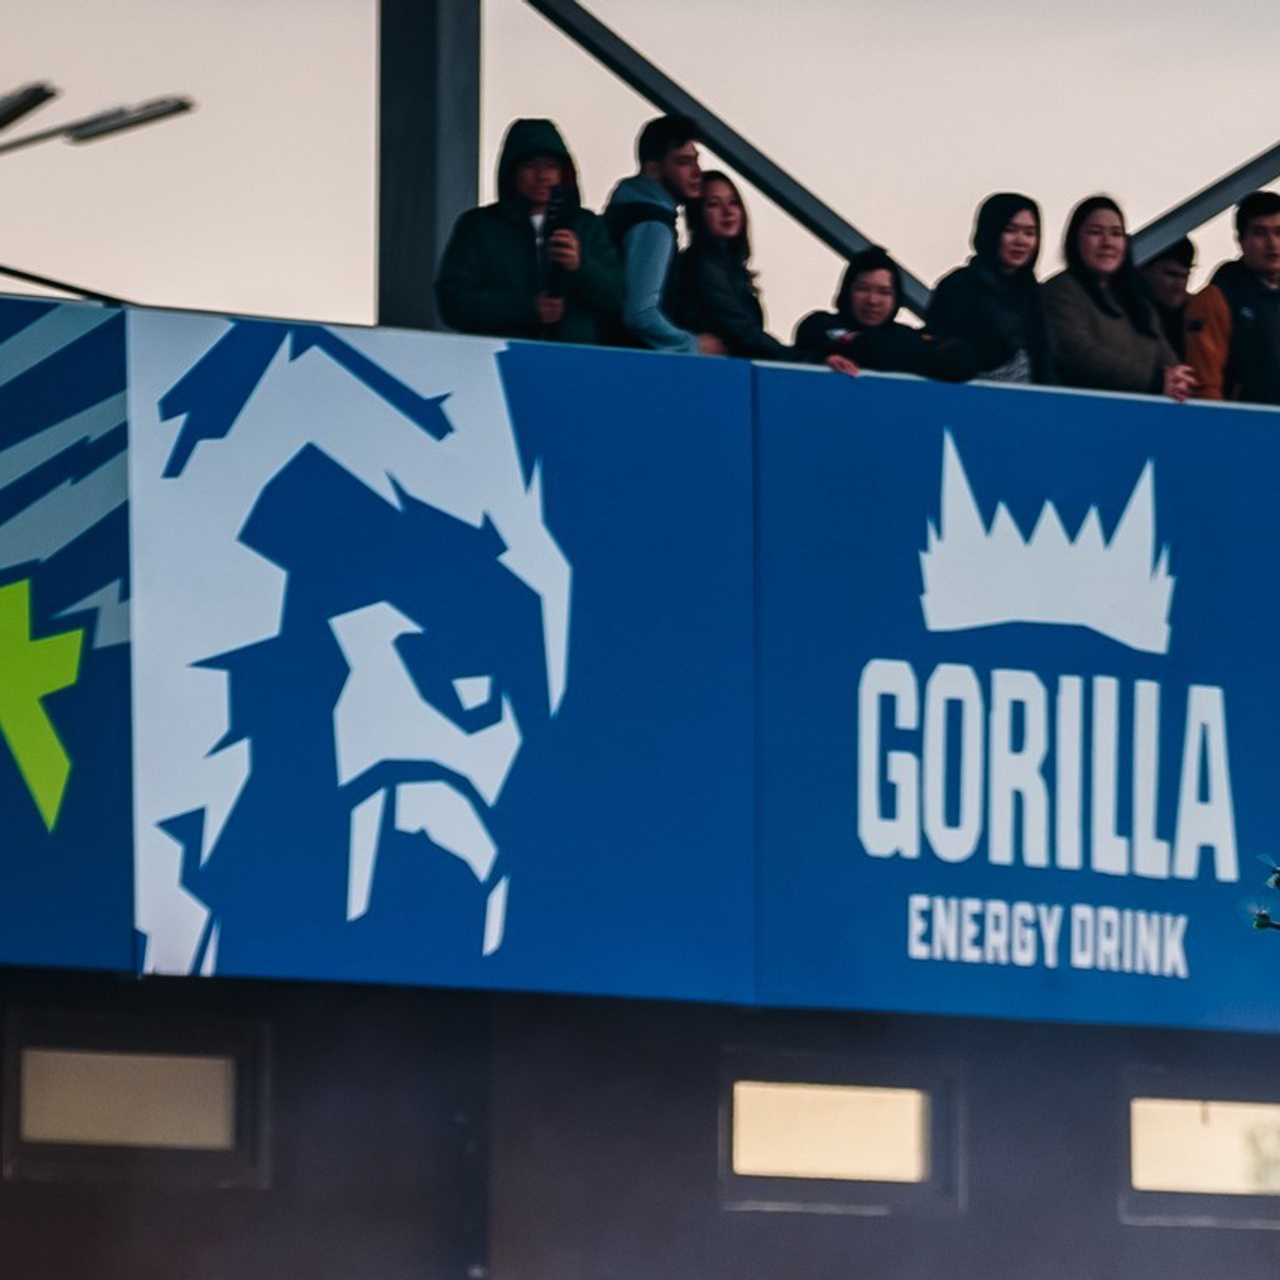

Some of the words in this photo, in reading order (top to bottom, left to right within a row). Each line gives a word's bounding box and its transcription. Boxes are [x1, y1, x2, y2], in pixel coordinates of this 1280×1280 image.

[858, 658, 1239, 883] GORILLA
[909, 895, 1062, 967] ENERGY
[1072, 904, 1187, 978] DRINK
